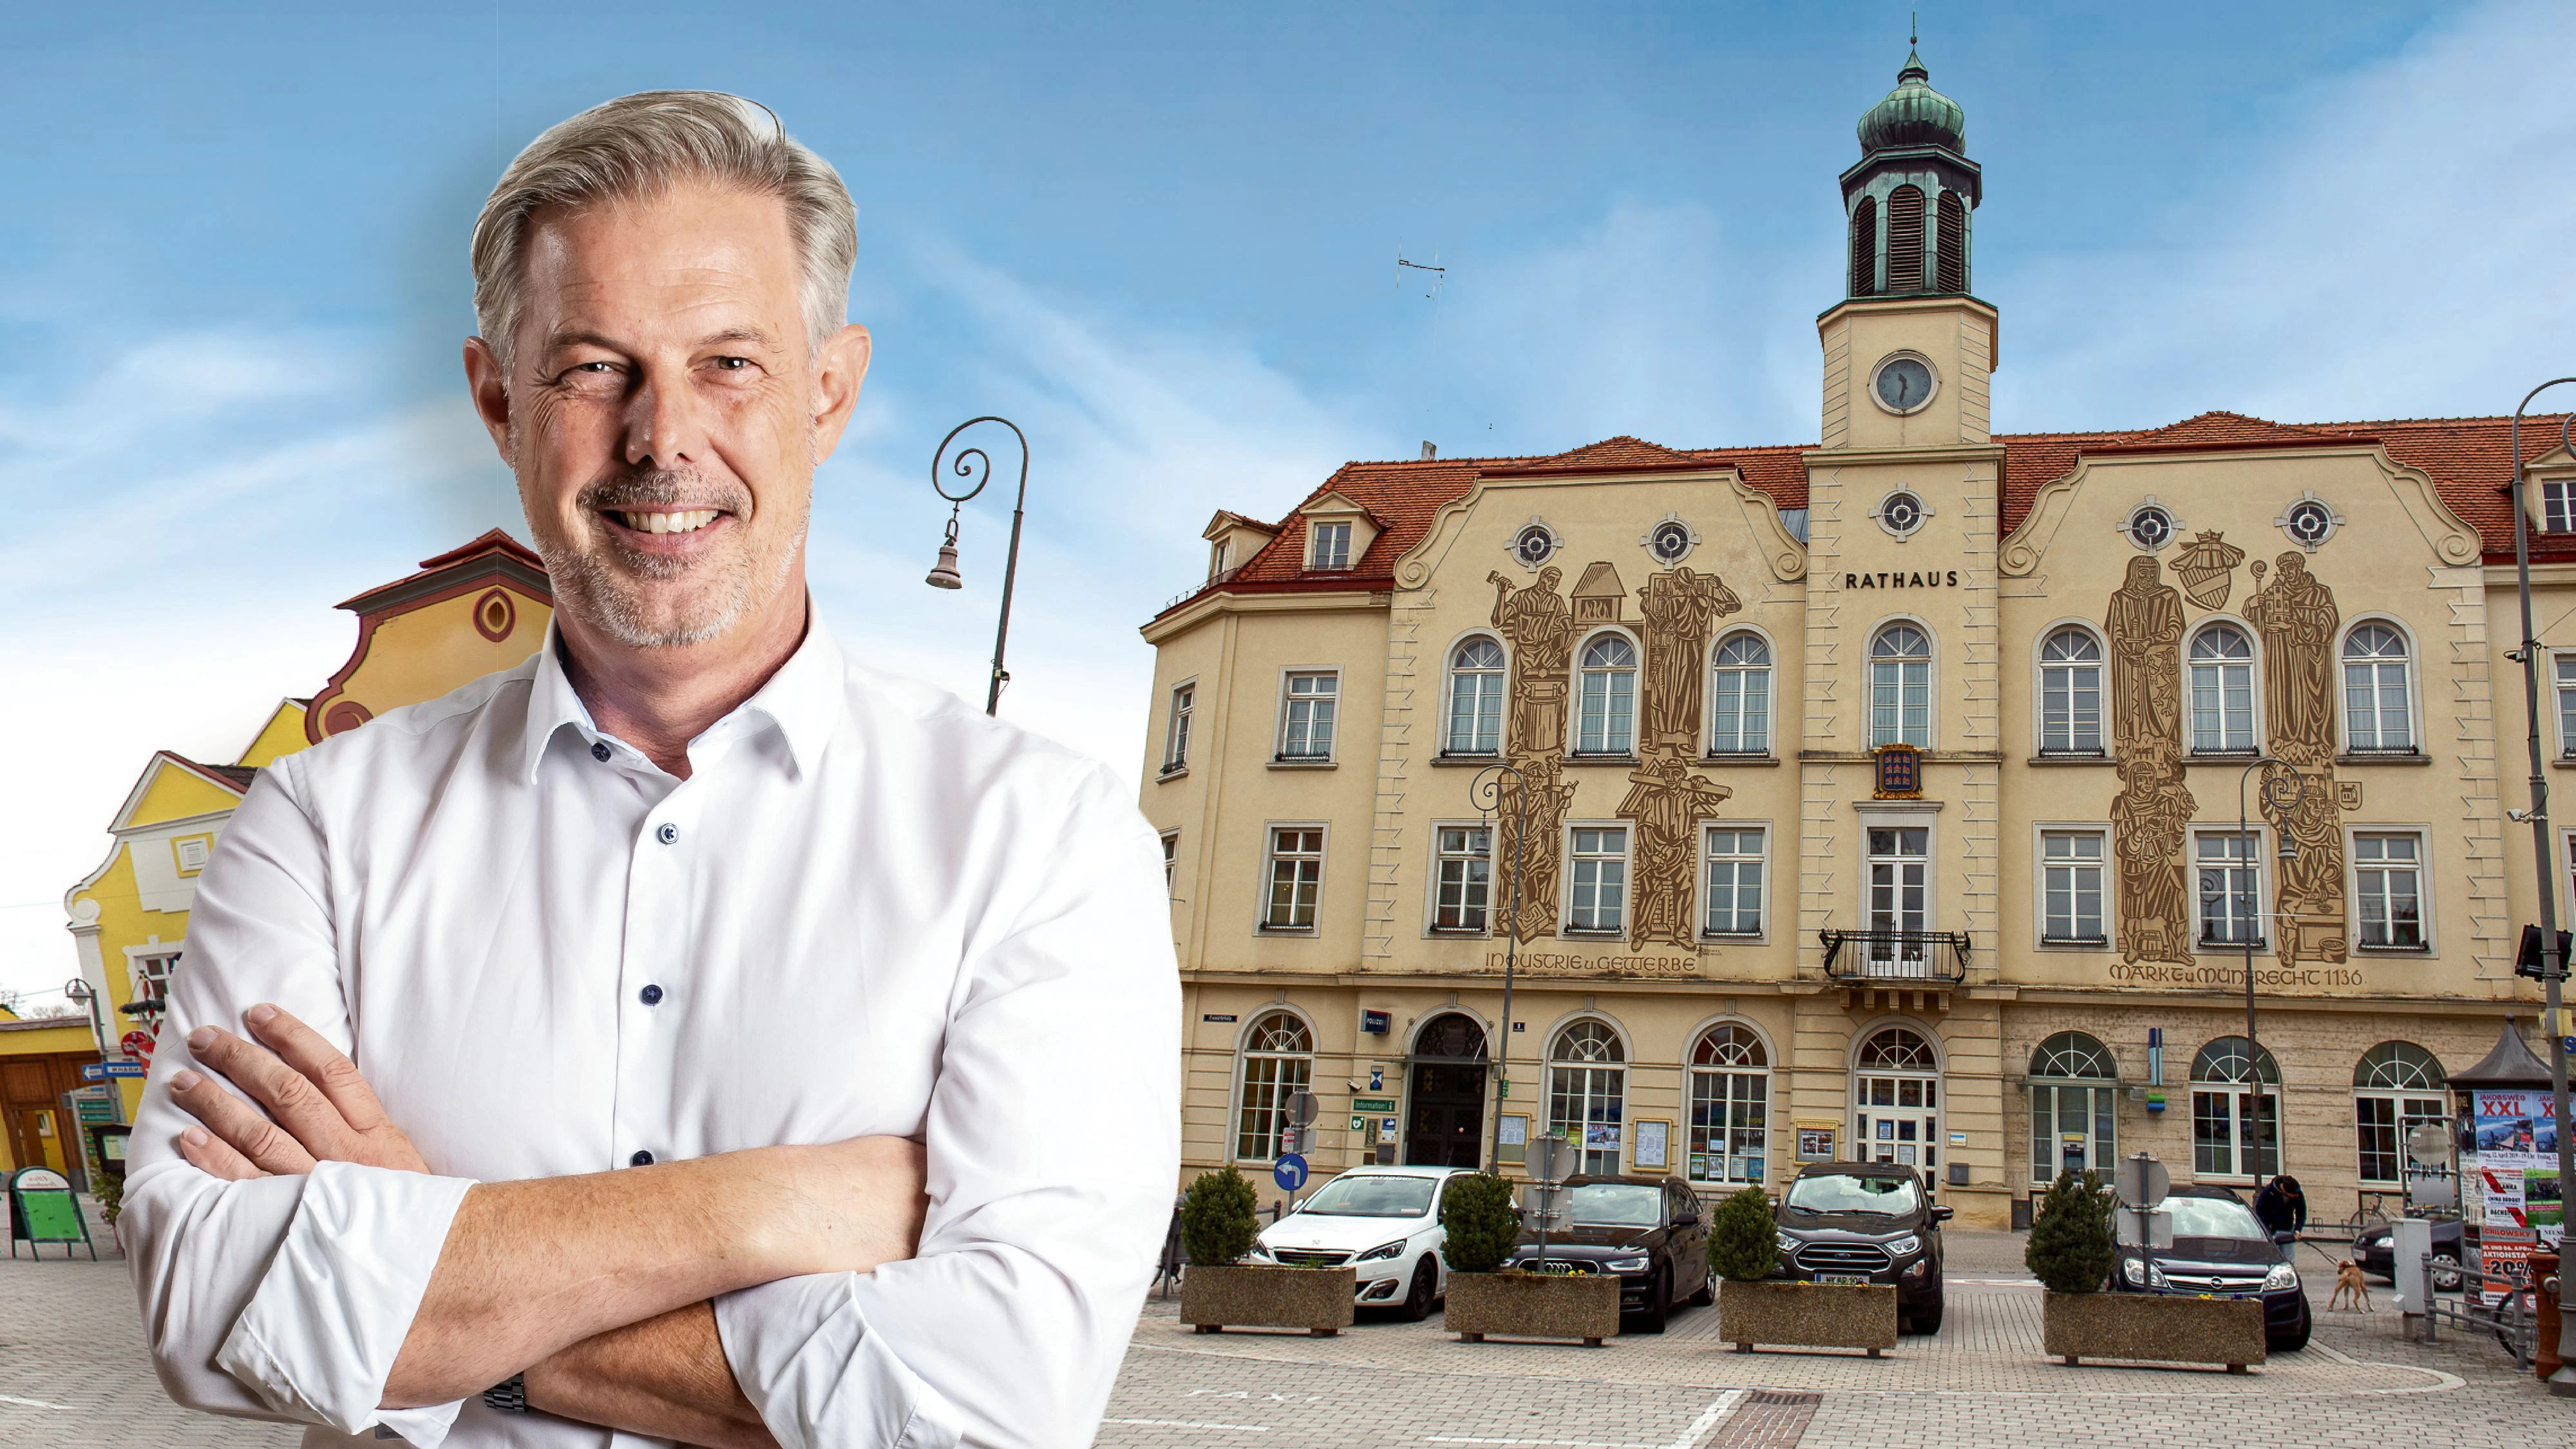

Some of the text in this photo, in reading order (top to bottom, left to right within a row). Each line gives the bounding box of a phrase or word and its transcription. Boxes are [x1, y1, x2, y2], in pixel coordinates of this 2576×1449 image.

[1845, 571, 1958, 589] RATHAUS
[1597, 956, 1696, 973] GEWERBE
[2109, 964, 2183, 982] MARKT
[2197, 967, 2320, 985] MÜNRECHT
[2324, 969, 2363, 985] 1136
[1355, 1101, 1385, 1110] Information
[2482, 1101, 2526, 1117] XXL
[2481, 1227, 2530, 1237] SCHILOWSKY
[1184, 1389, 1324, 1403] TAXI
